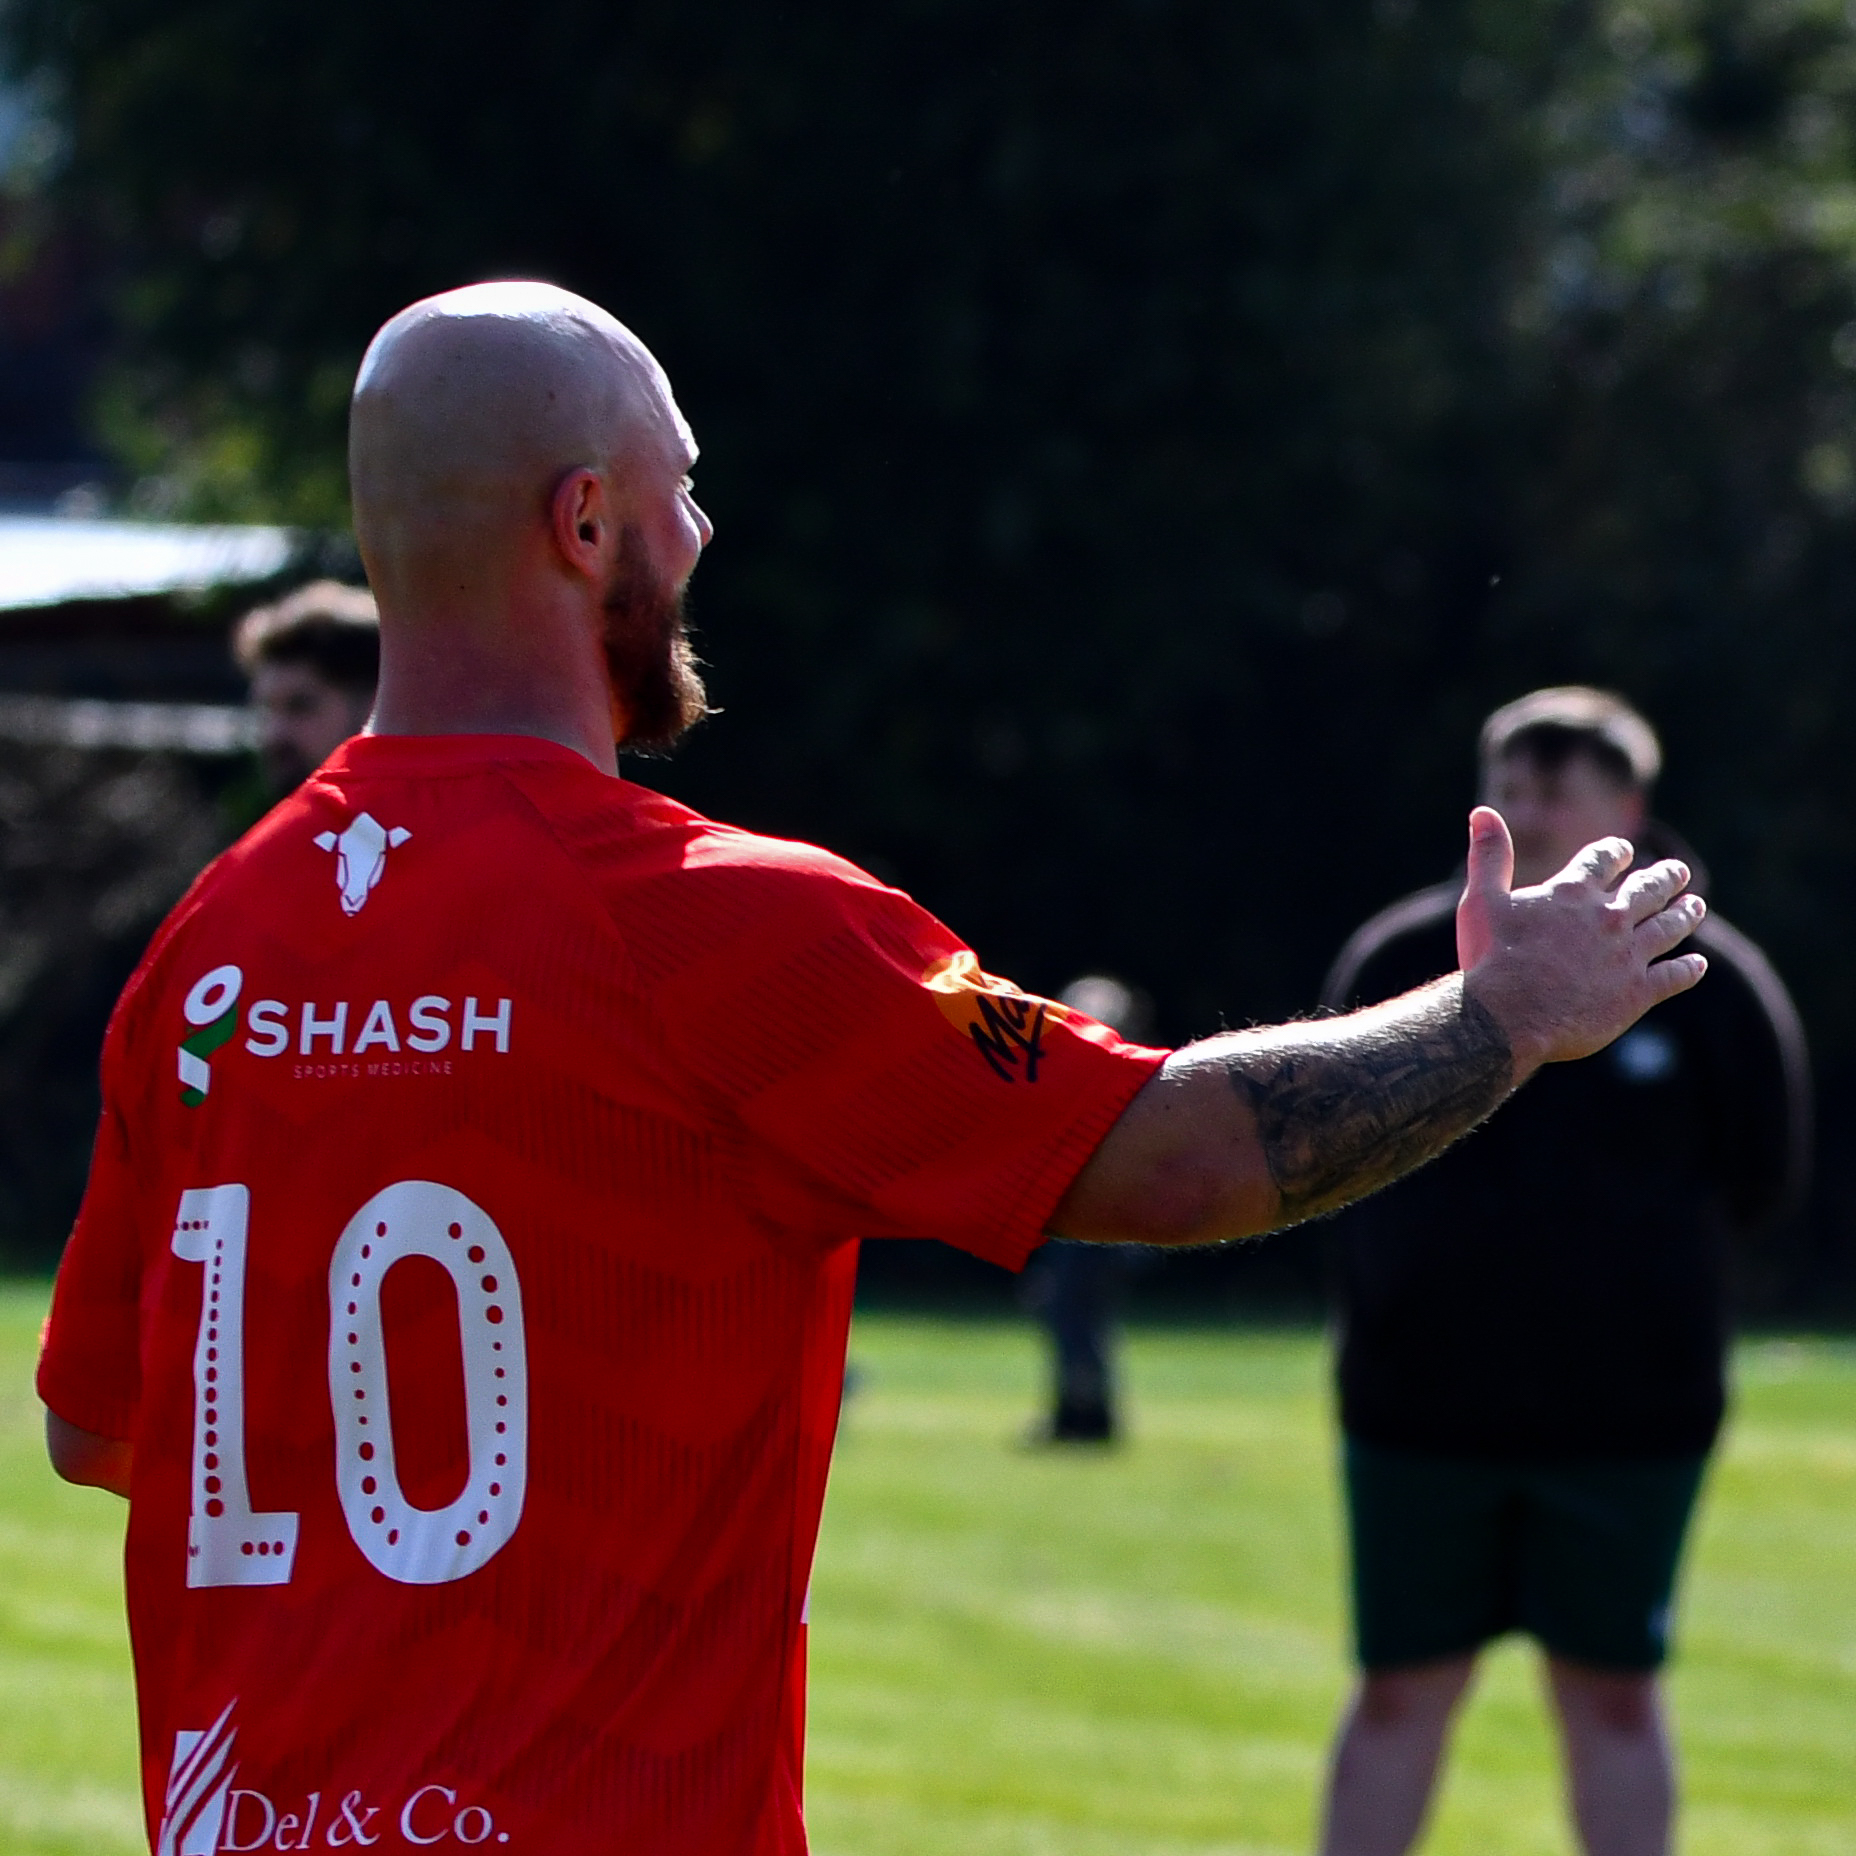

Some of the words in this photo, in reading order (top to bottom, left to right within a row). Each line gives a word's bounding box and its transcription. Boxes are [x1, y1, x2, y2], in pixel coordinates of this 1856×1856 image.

[245, 995, 512, 1058] SHASH
[293, 1063, 360, 1079] SPORTS
[171, 1180, 528, 1588] 10
[219, 1790, 321, 1852] Del
[327, 1789, 381, 1848] &
[400, 1785, 510, 1846] Co.
